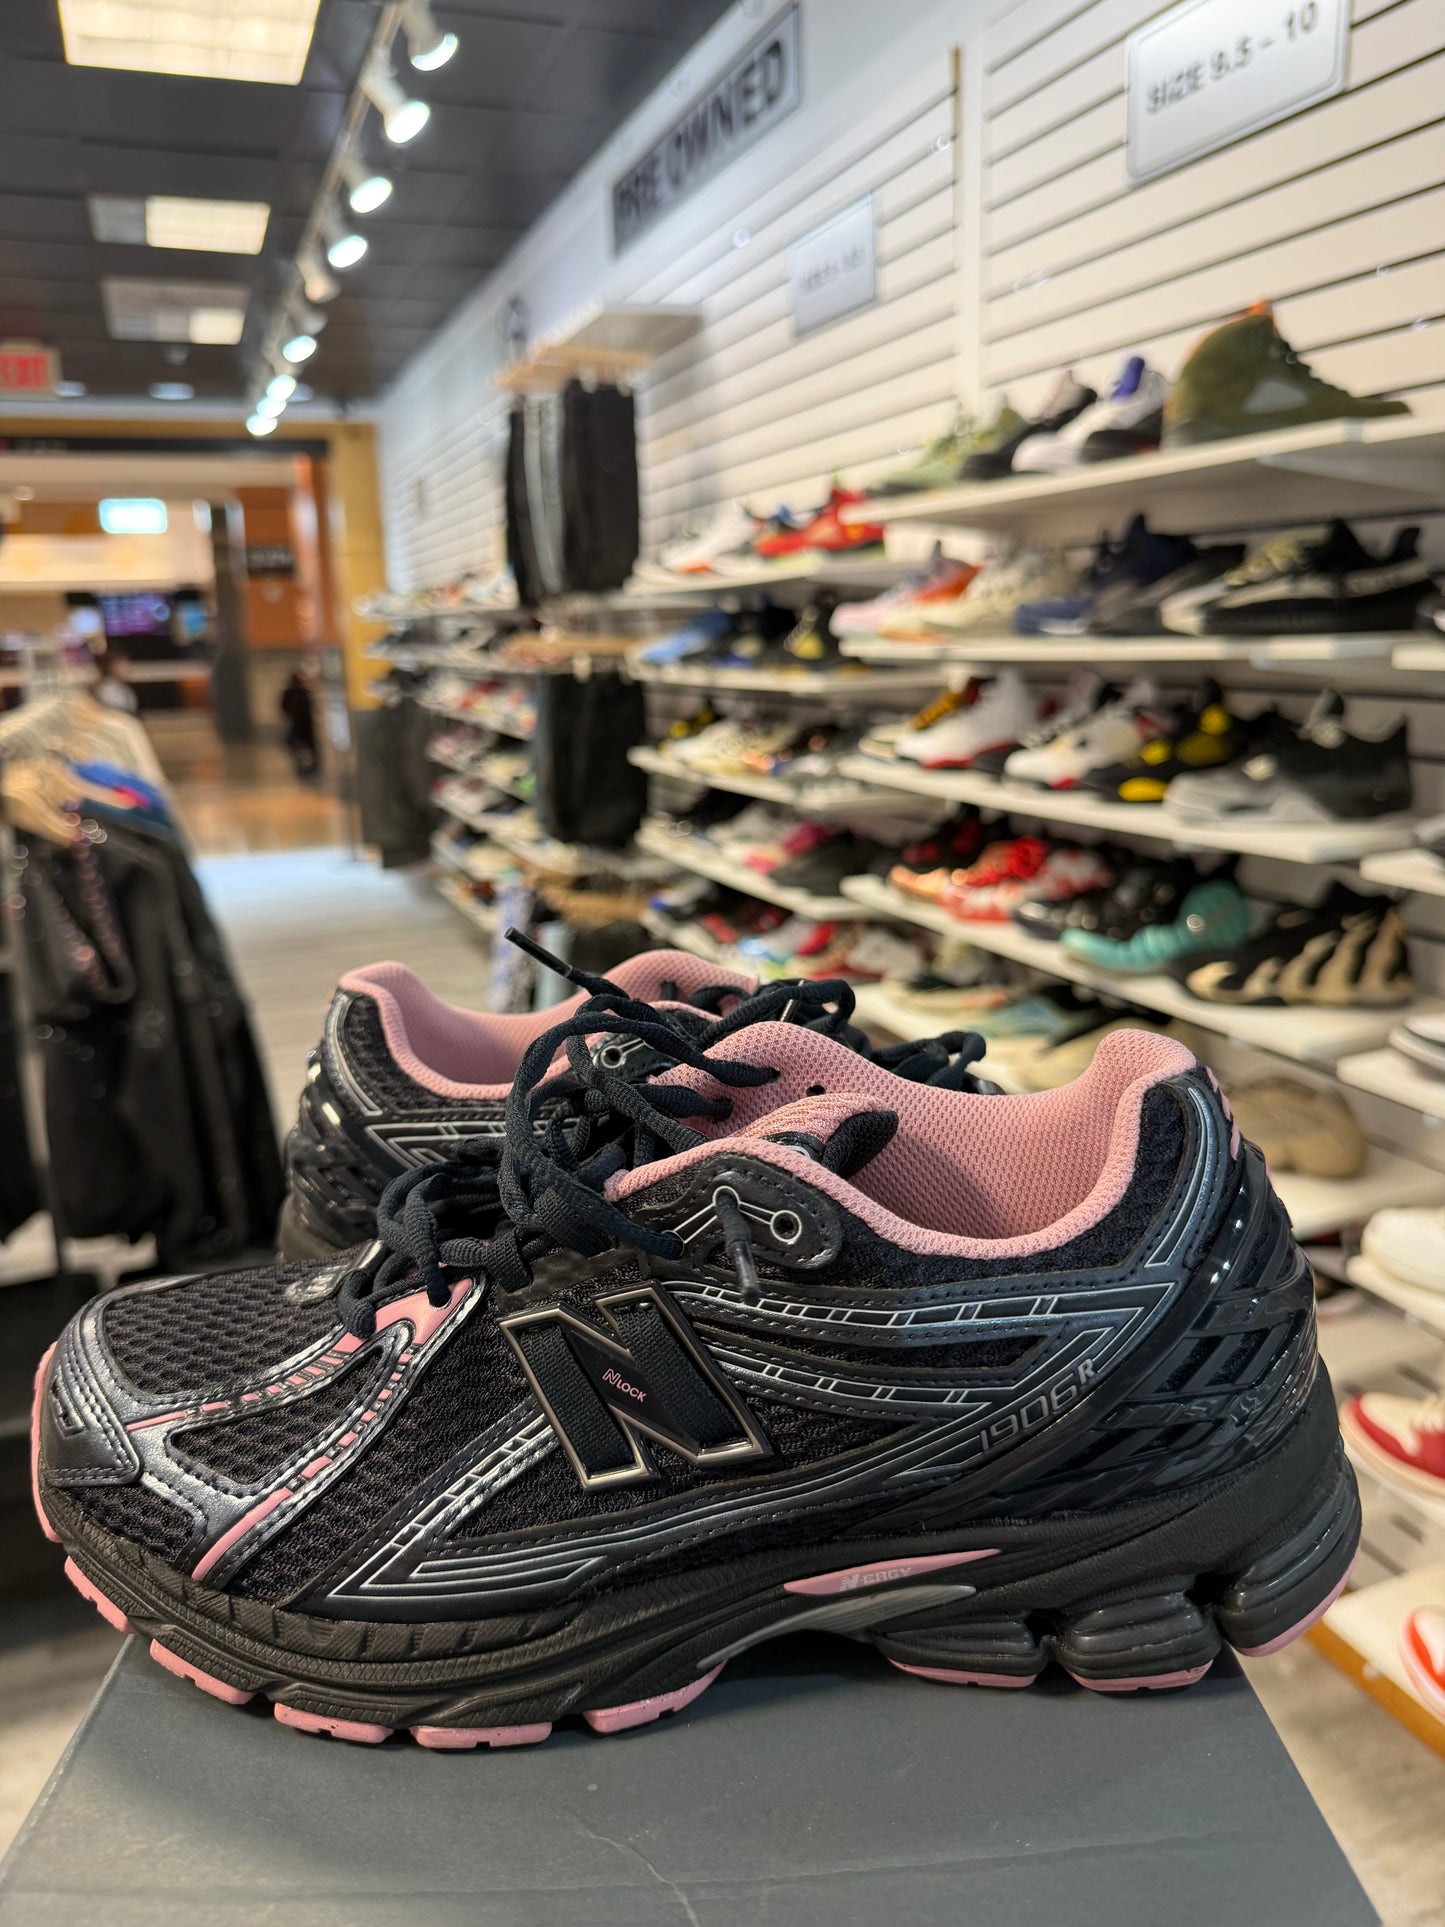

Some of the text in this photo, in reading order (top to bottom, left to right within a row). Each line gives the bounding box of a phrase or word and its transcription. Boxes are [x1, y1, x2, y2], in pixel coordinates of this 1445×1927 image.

[663, 38, 783, 192] OWNED
[1146, 59, 1205, 115] SIZE
[1209, 35, 1253, 81] 9.5
[1284, 0, 1318, 40] 10
[979, 1358, 1098, 1451] 1906R
